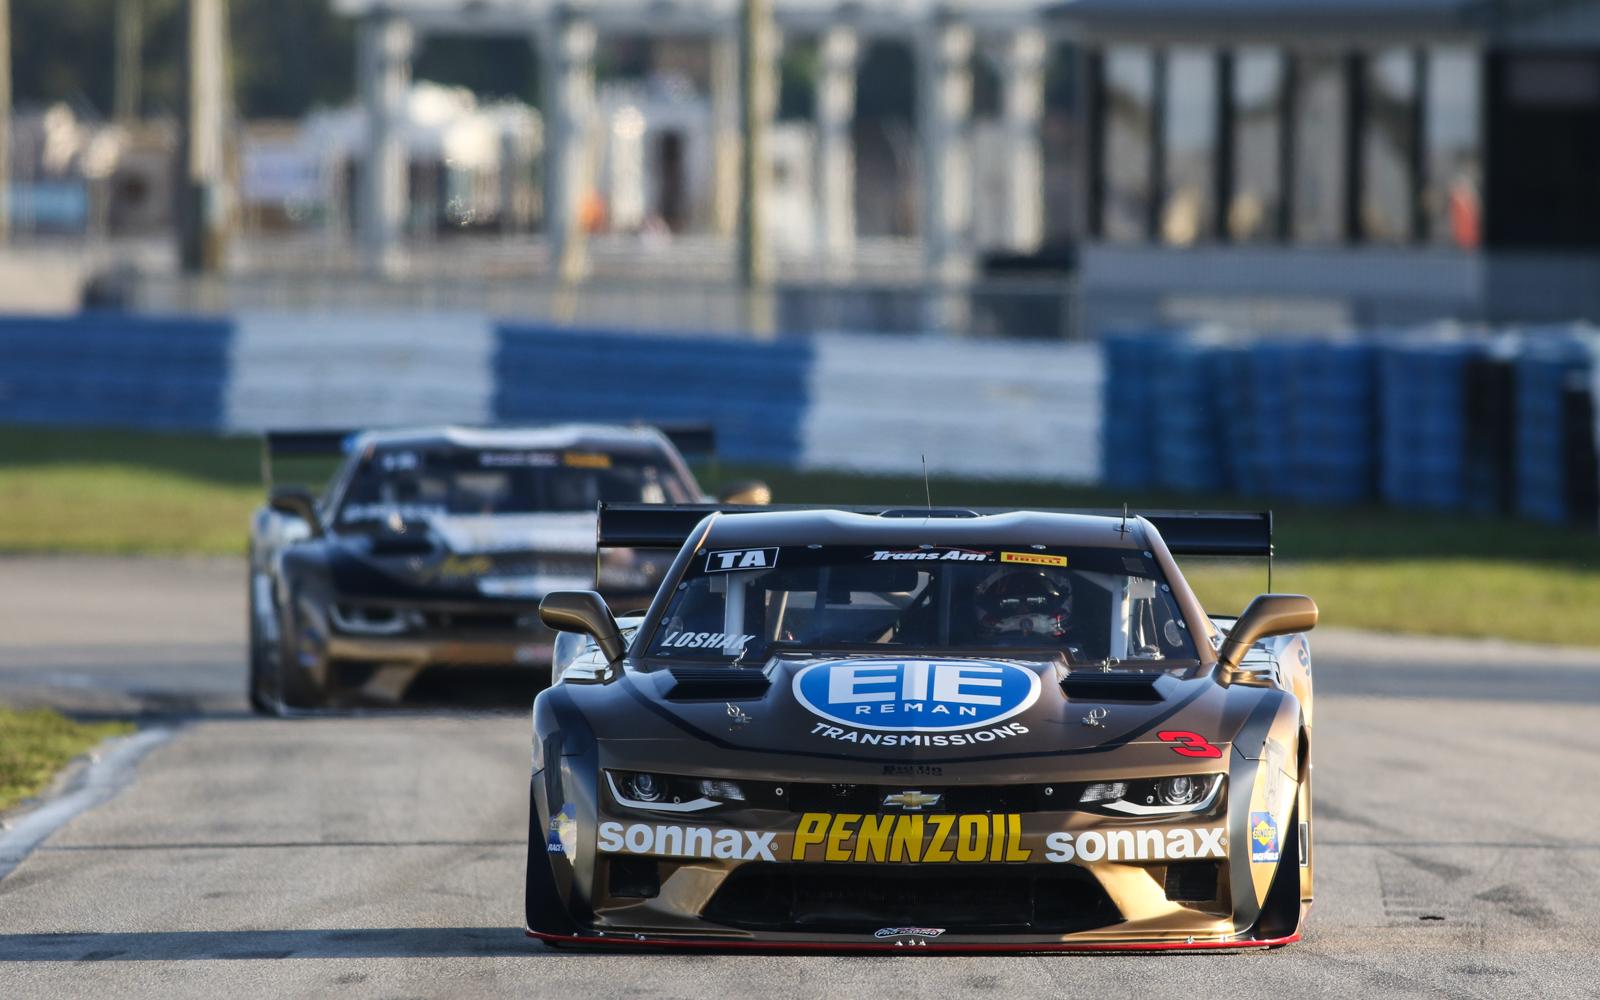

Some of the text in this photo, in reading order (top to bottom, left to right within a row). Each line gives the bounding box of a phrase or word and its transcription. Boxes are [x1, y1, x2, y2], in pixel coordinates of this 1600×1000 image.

[717, 550, 766, 569] TA
[872, 550, 939, 561] Trans
[940, 550, 987, 561] Am
[660, 631, 756, 650] LOSHAK
[828, 661, 1003, 706] ETE
[855, 703, 977, 717] REMAN
[810, 722, 1029, 746] TRANSMISSIONS
[1157, 730, 1223, 759] 3
[791, 812, 1032, 863] PENNZOIL
